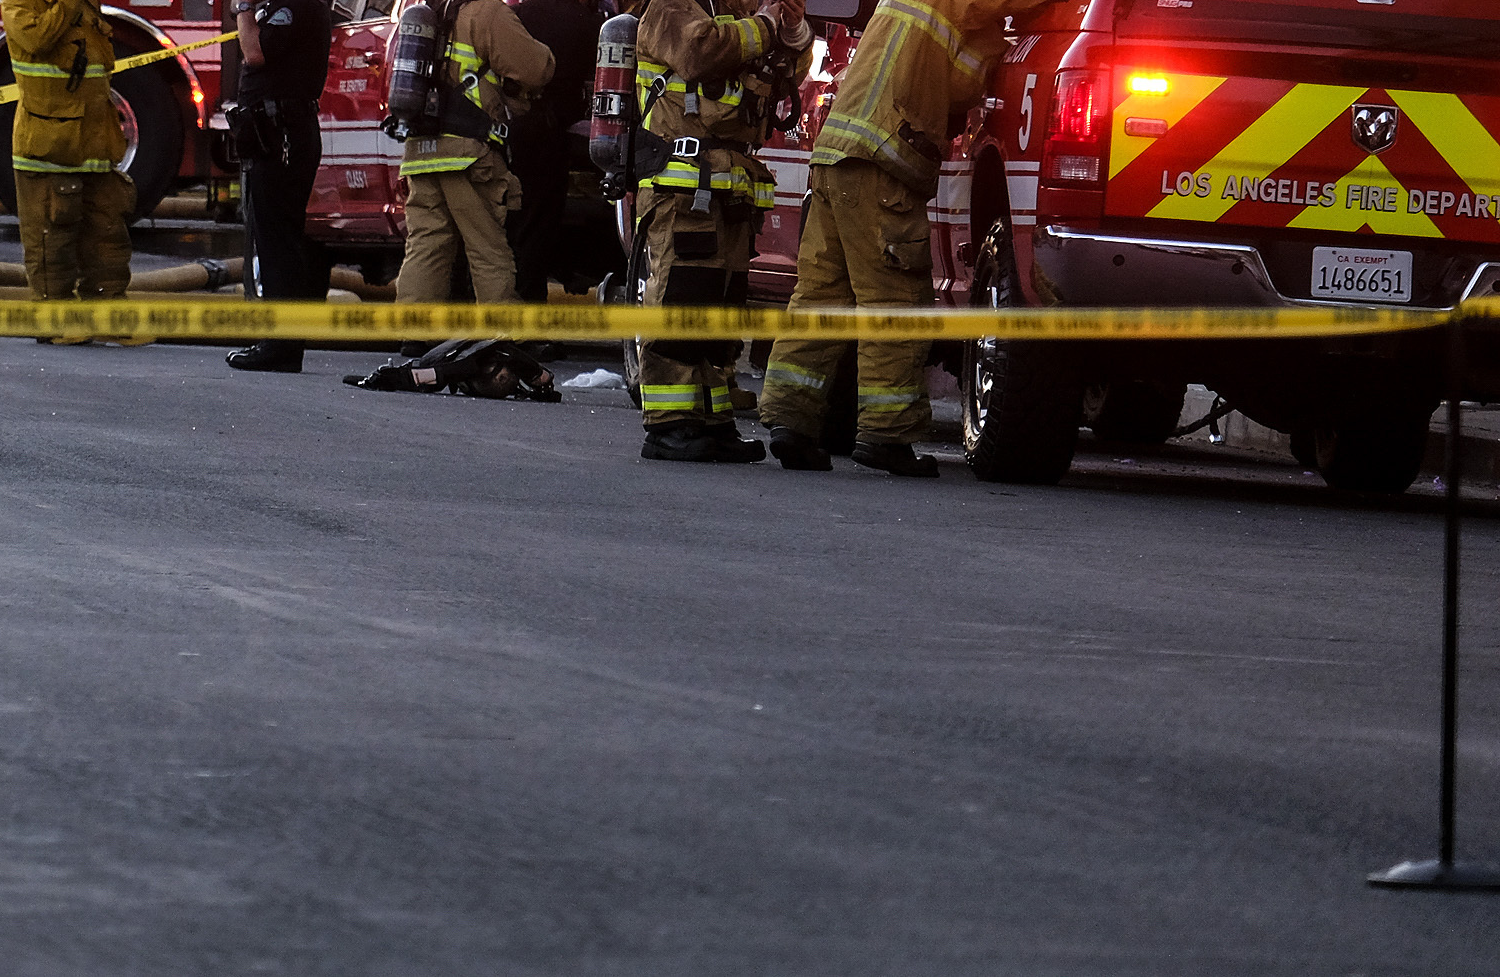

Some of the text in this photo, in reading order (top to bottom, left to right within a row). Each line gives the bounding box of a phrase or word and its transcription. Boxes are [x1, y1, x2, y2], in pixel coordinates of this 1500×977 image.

[1019, 73, 1037, 151] 5
[1161, 171, 1212, 198] LOS
[1222, 175, 1336, 208] ANGELES
[1347, 184, 1398, 211] FIRE
[1337, 255, 1388, 265] CA EXEMPT
[1318, 266, 1404, 294] 1486651
